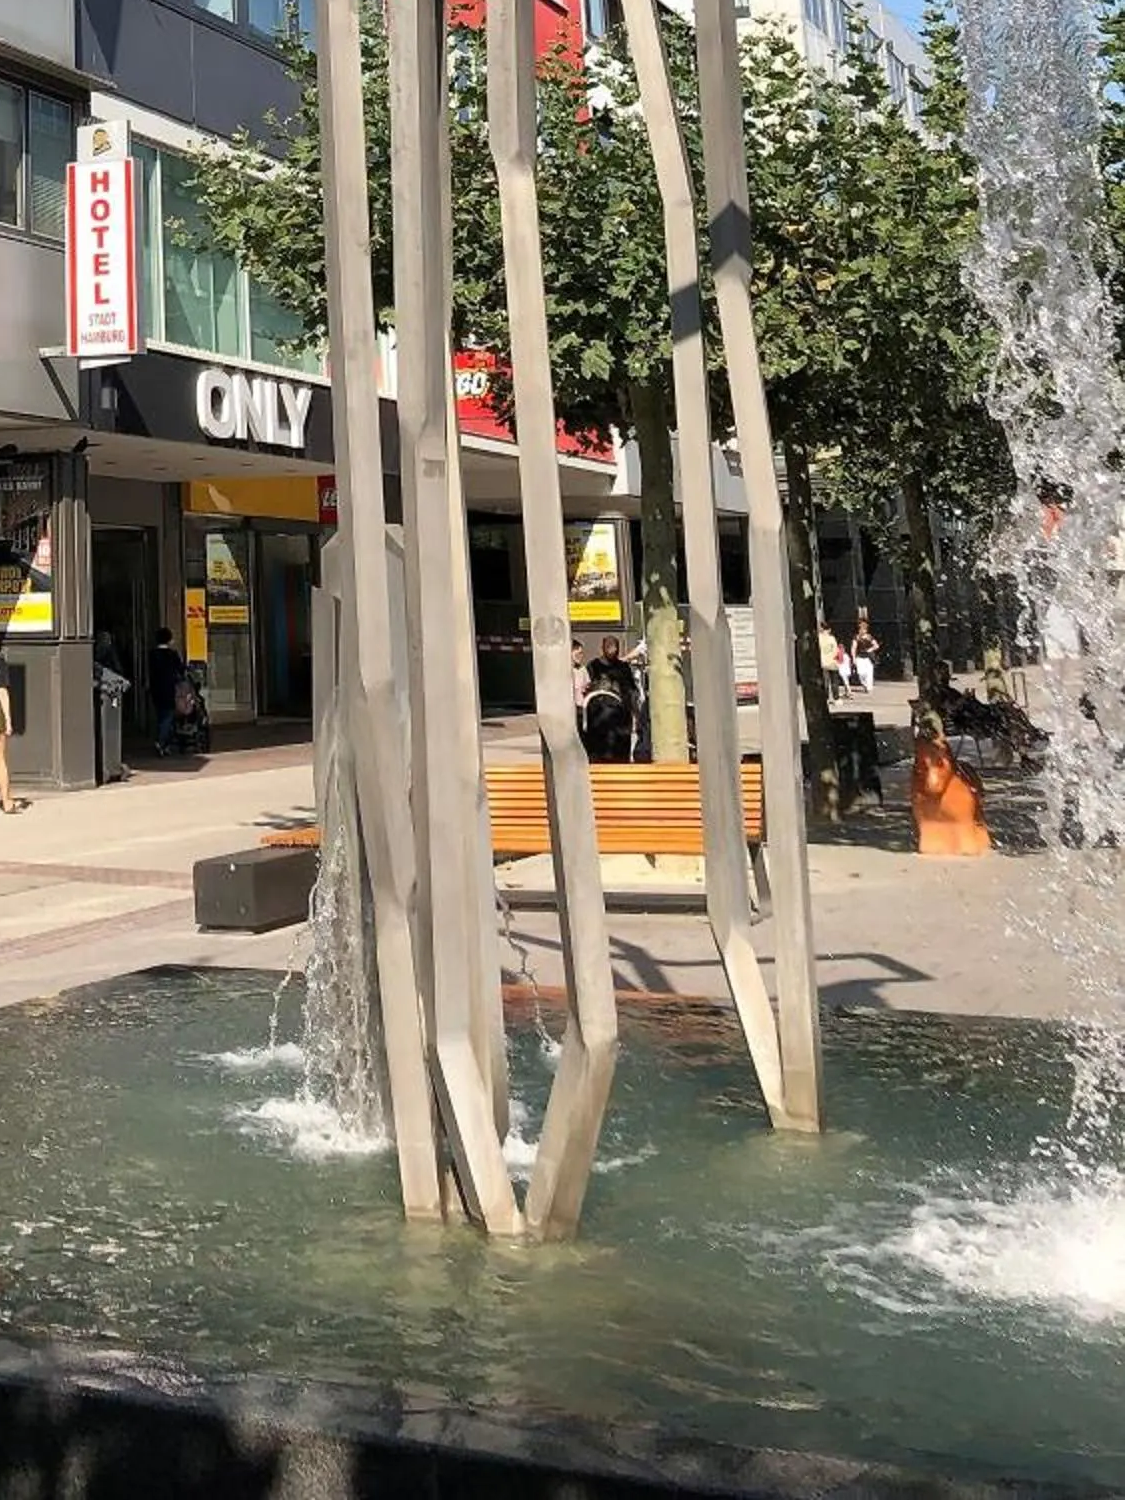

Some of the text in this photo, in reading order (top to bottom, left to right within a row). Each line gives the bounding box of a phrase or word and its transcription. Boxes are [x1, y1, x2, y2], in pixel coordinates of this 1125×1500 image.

[90, 170, 113, 306] HOTEL
[88, 311, 117, 327] STADT
[196, 369, 313, 449] ONLY
